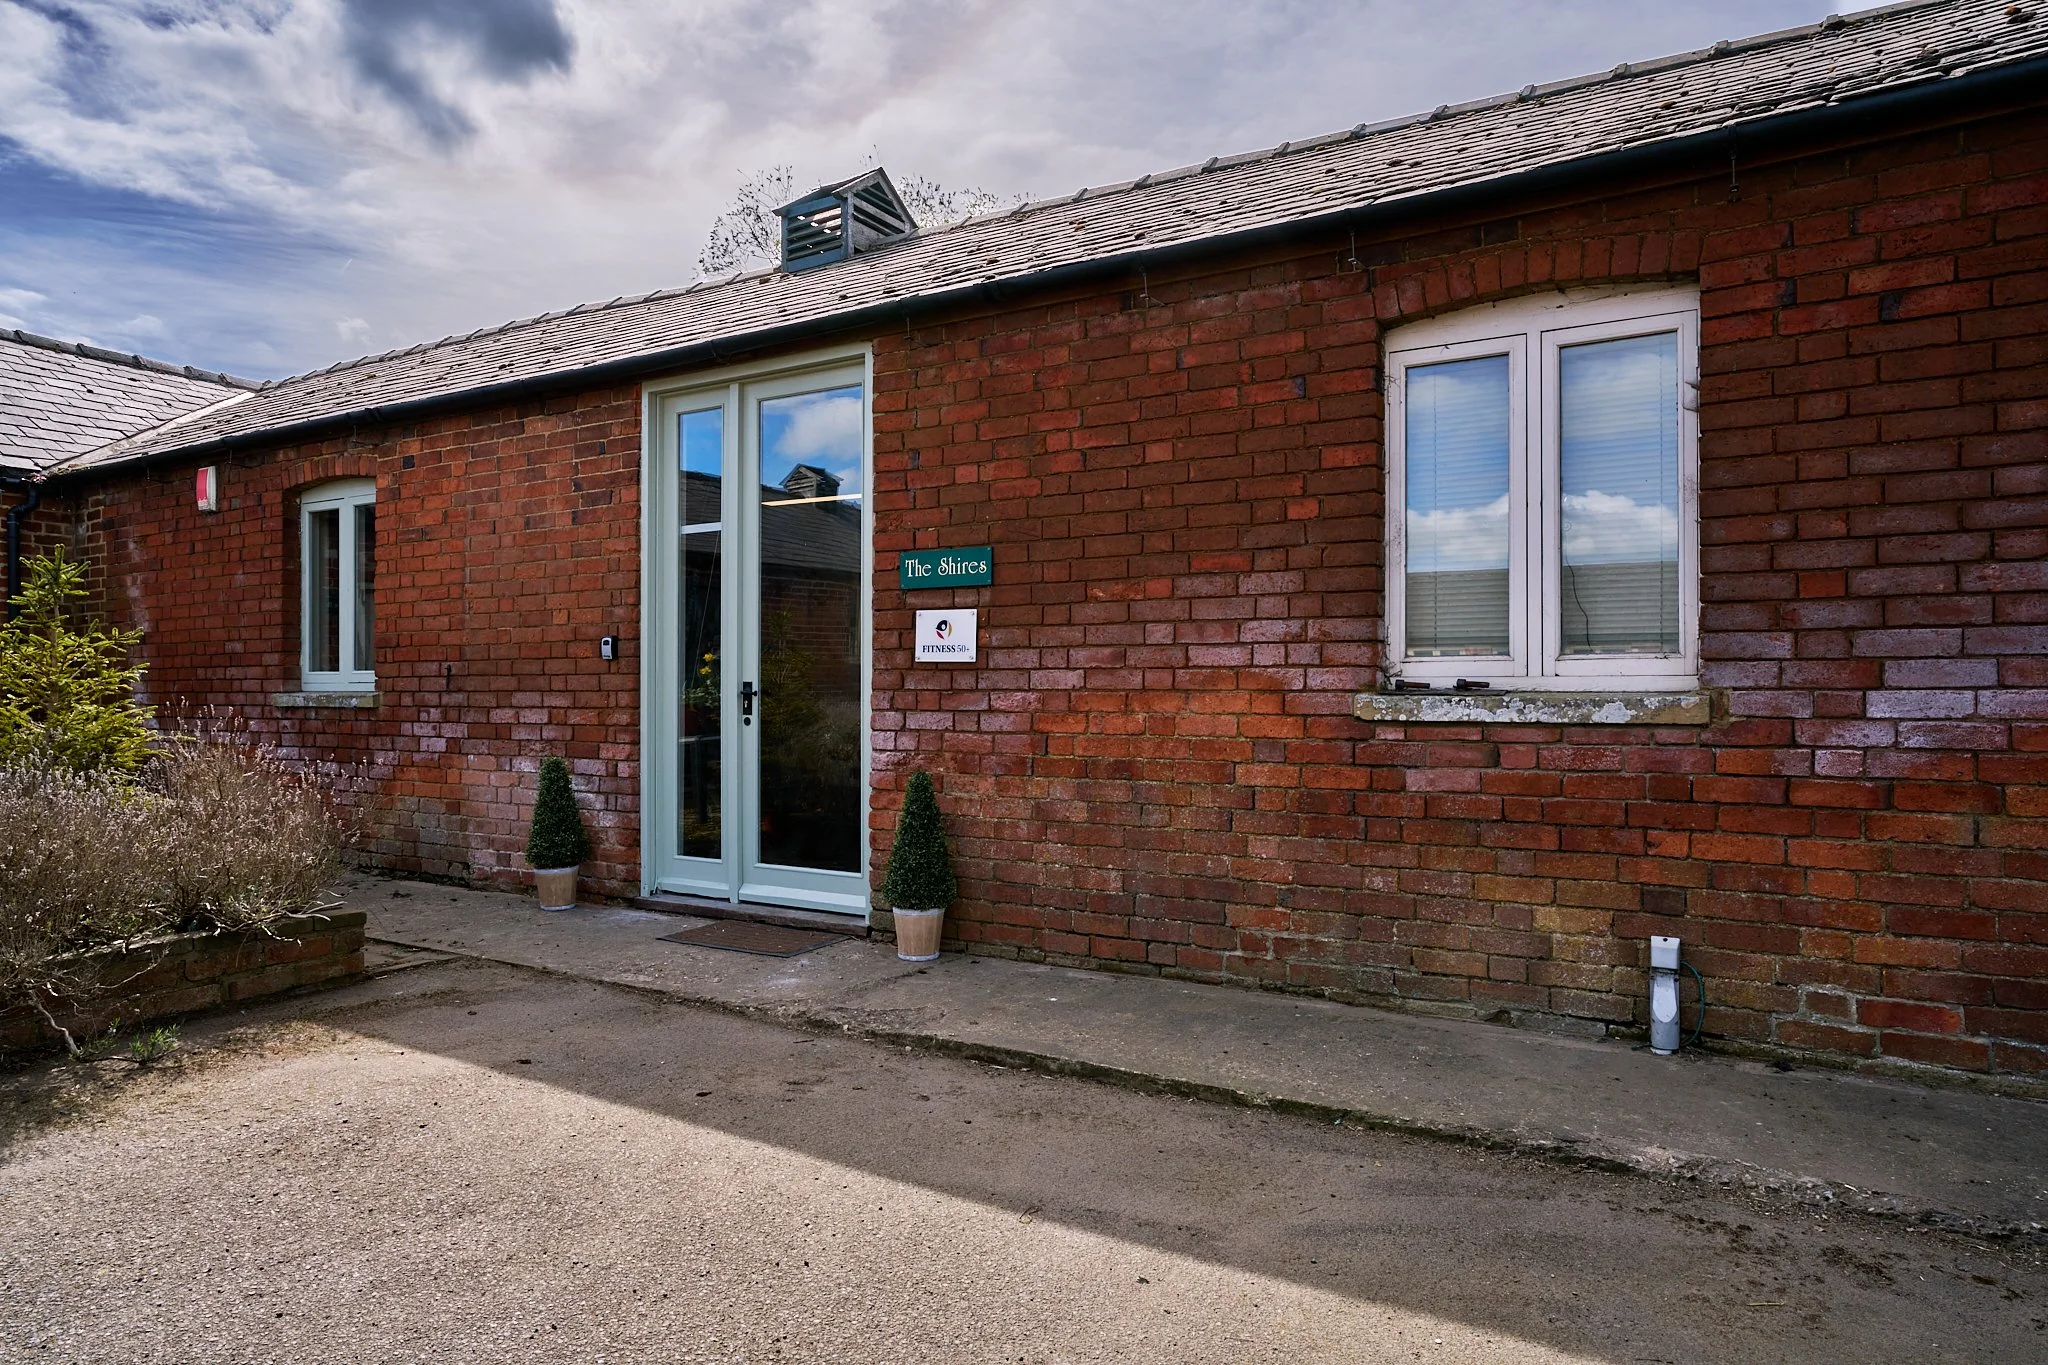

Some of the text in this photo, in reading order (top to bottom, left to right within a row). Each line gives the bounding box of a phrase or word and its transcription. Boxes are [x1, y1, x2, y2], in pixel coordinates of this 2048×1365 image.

[905, 556, 987, 577] The Shires
[922, 644, 956, 653] FITNESS
